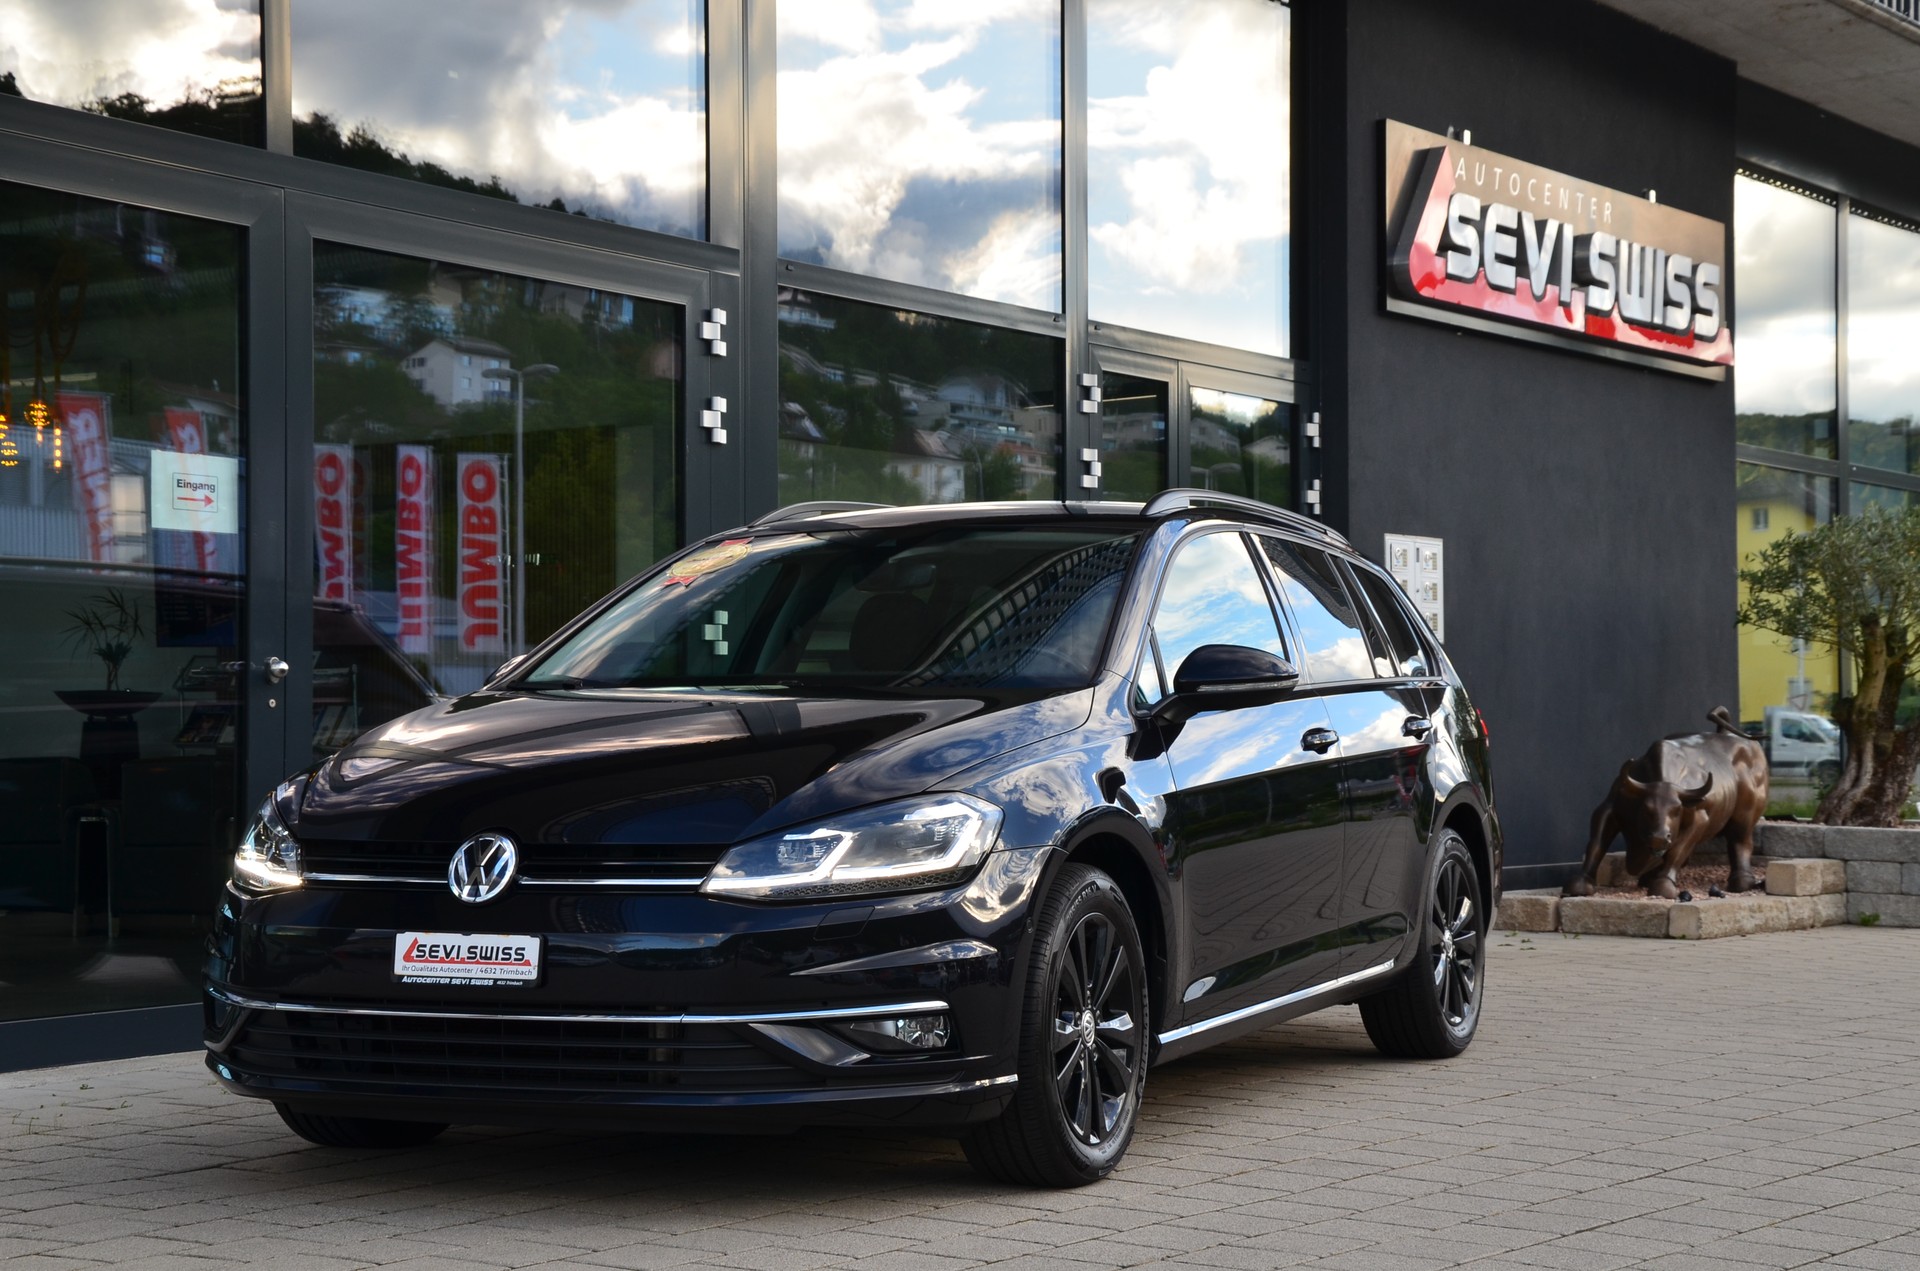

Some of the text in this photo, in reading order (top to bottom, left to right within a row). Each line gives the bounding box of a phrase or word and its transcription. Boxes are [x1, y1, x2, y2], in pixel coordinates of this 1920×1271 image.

[1454, 156, 1612, 224] AUTOCENTER
[1446, 192, 1721, 343] SEVI SWISS
[176, 478, 216, 493] Eingang
[415, 943, 526, 962] SEVI SWISS
[438, 966, 474, 974] Autocenter
[499, 968, 533, 976] Trimbach
[470, 978, 495, 986] SWISS
